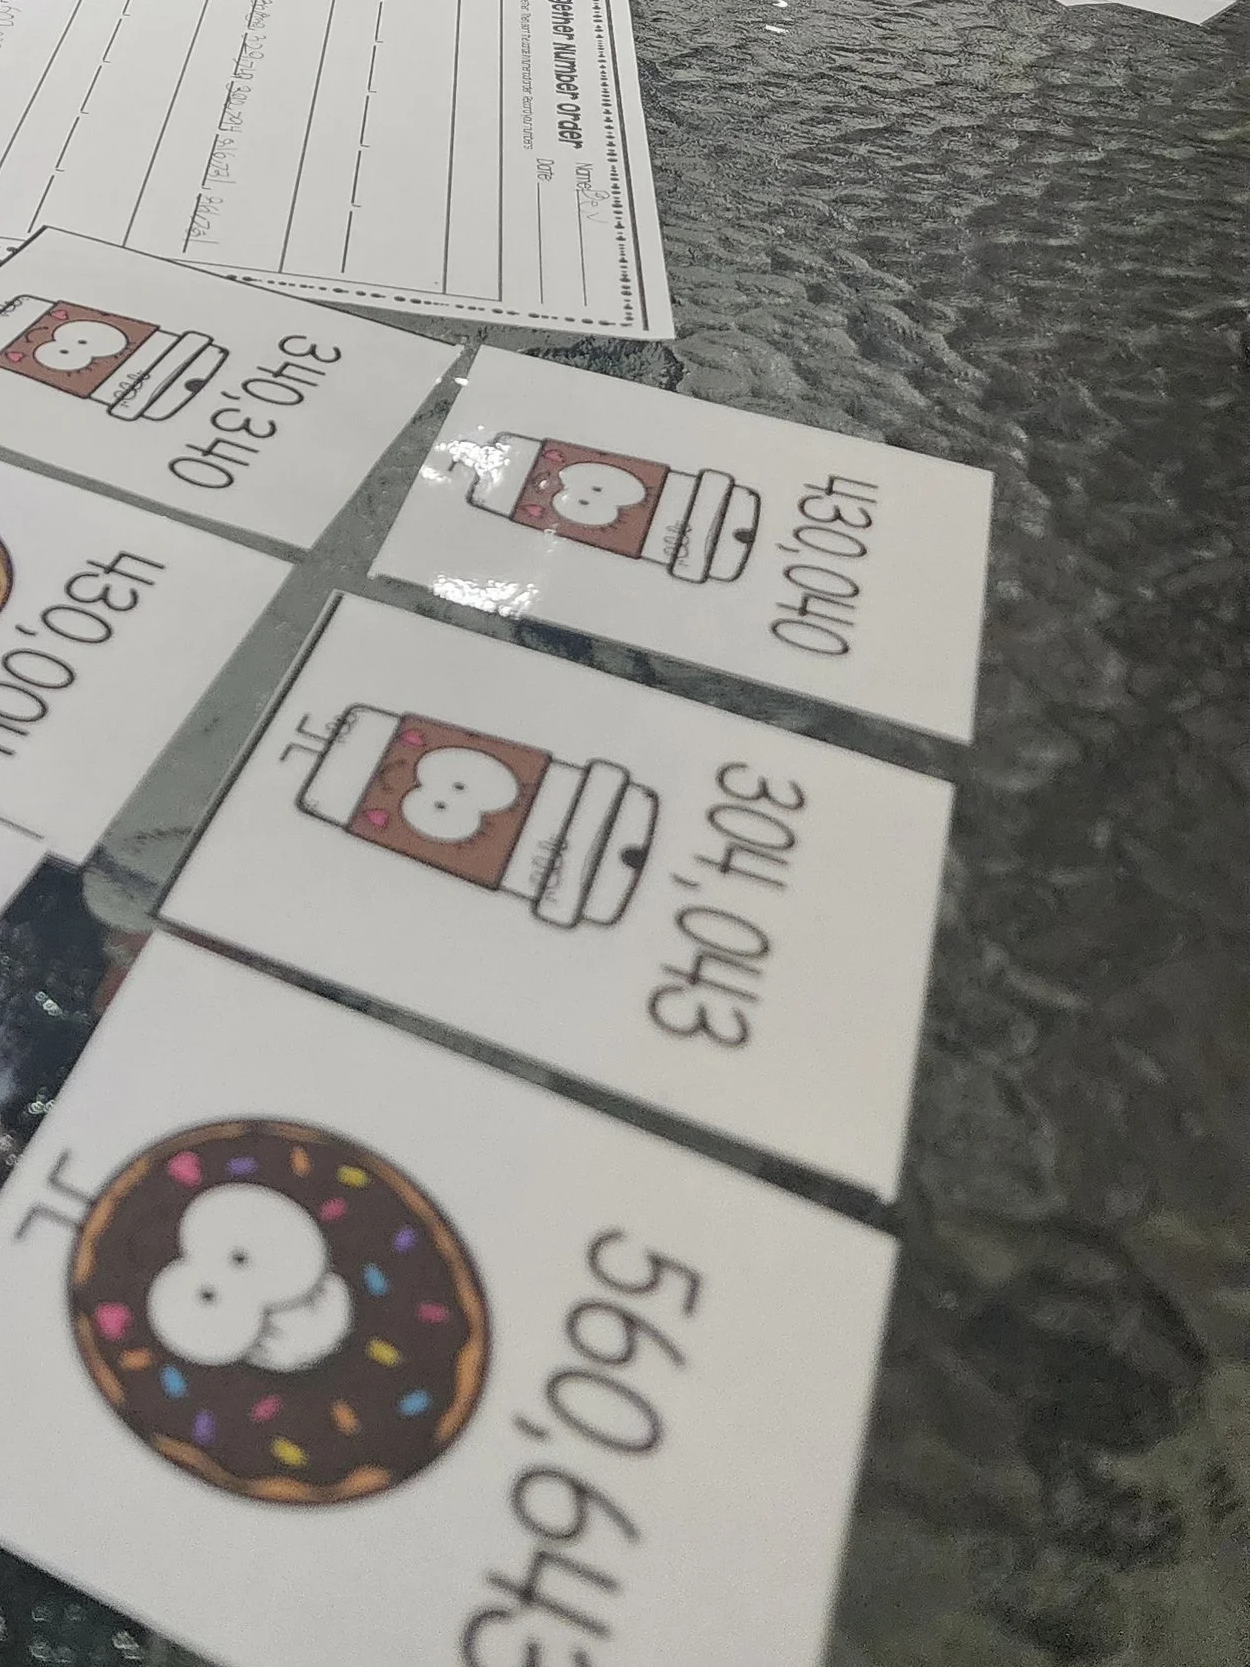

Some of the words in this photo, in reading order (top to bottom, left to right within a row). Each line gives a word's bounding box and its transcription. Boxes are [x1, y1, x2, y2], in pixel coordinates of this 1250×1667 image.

[552, 41, 581, 100] Number
[168, 334, 342, 489] 340,340
[769, 474, 879, 655] 430,040
[646, 760, 806, 1049] 304,043
